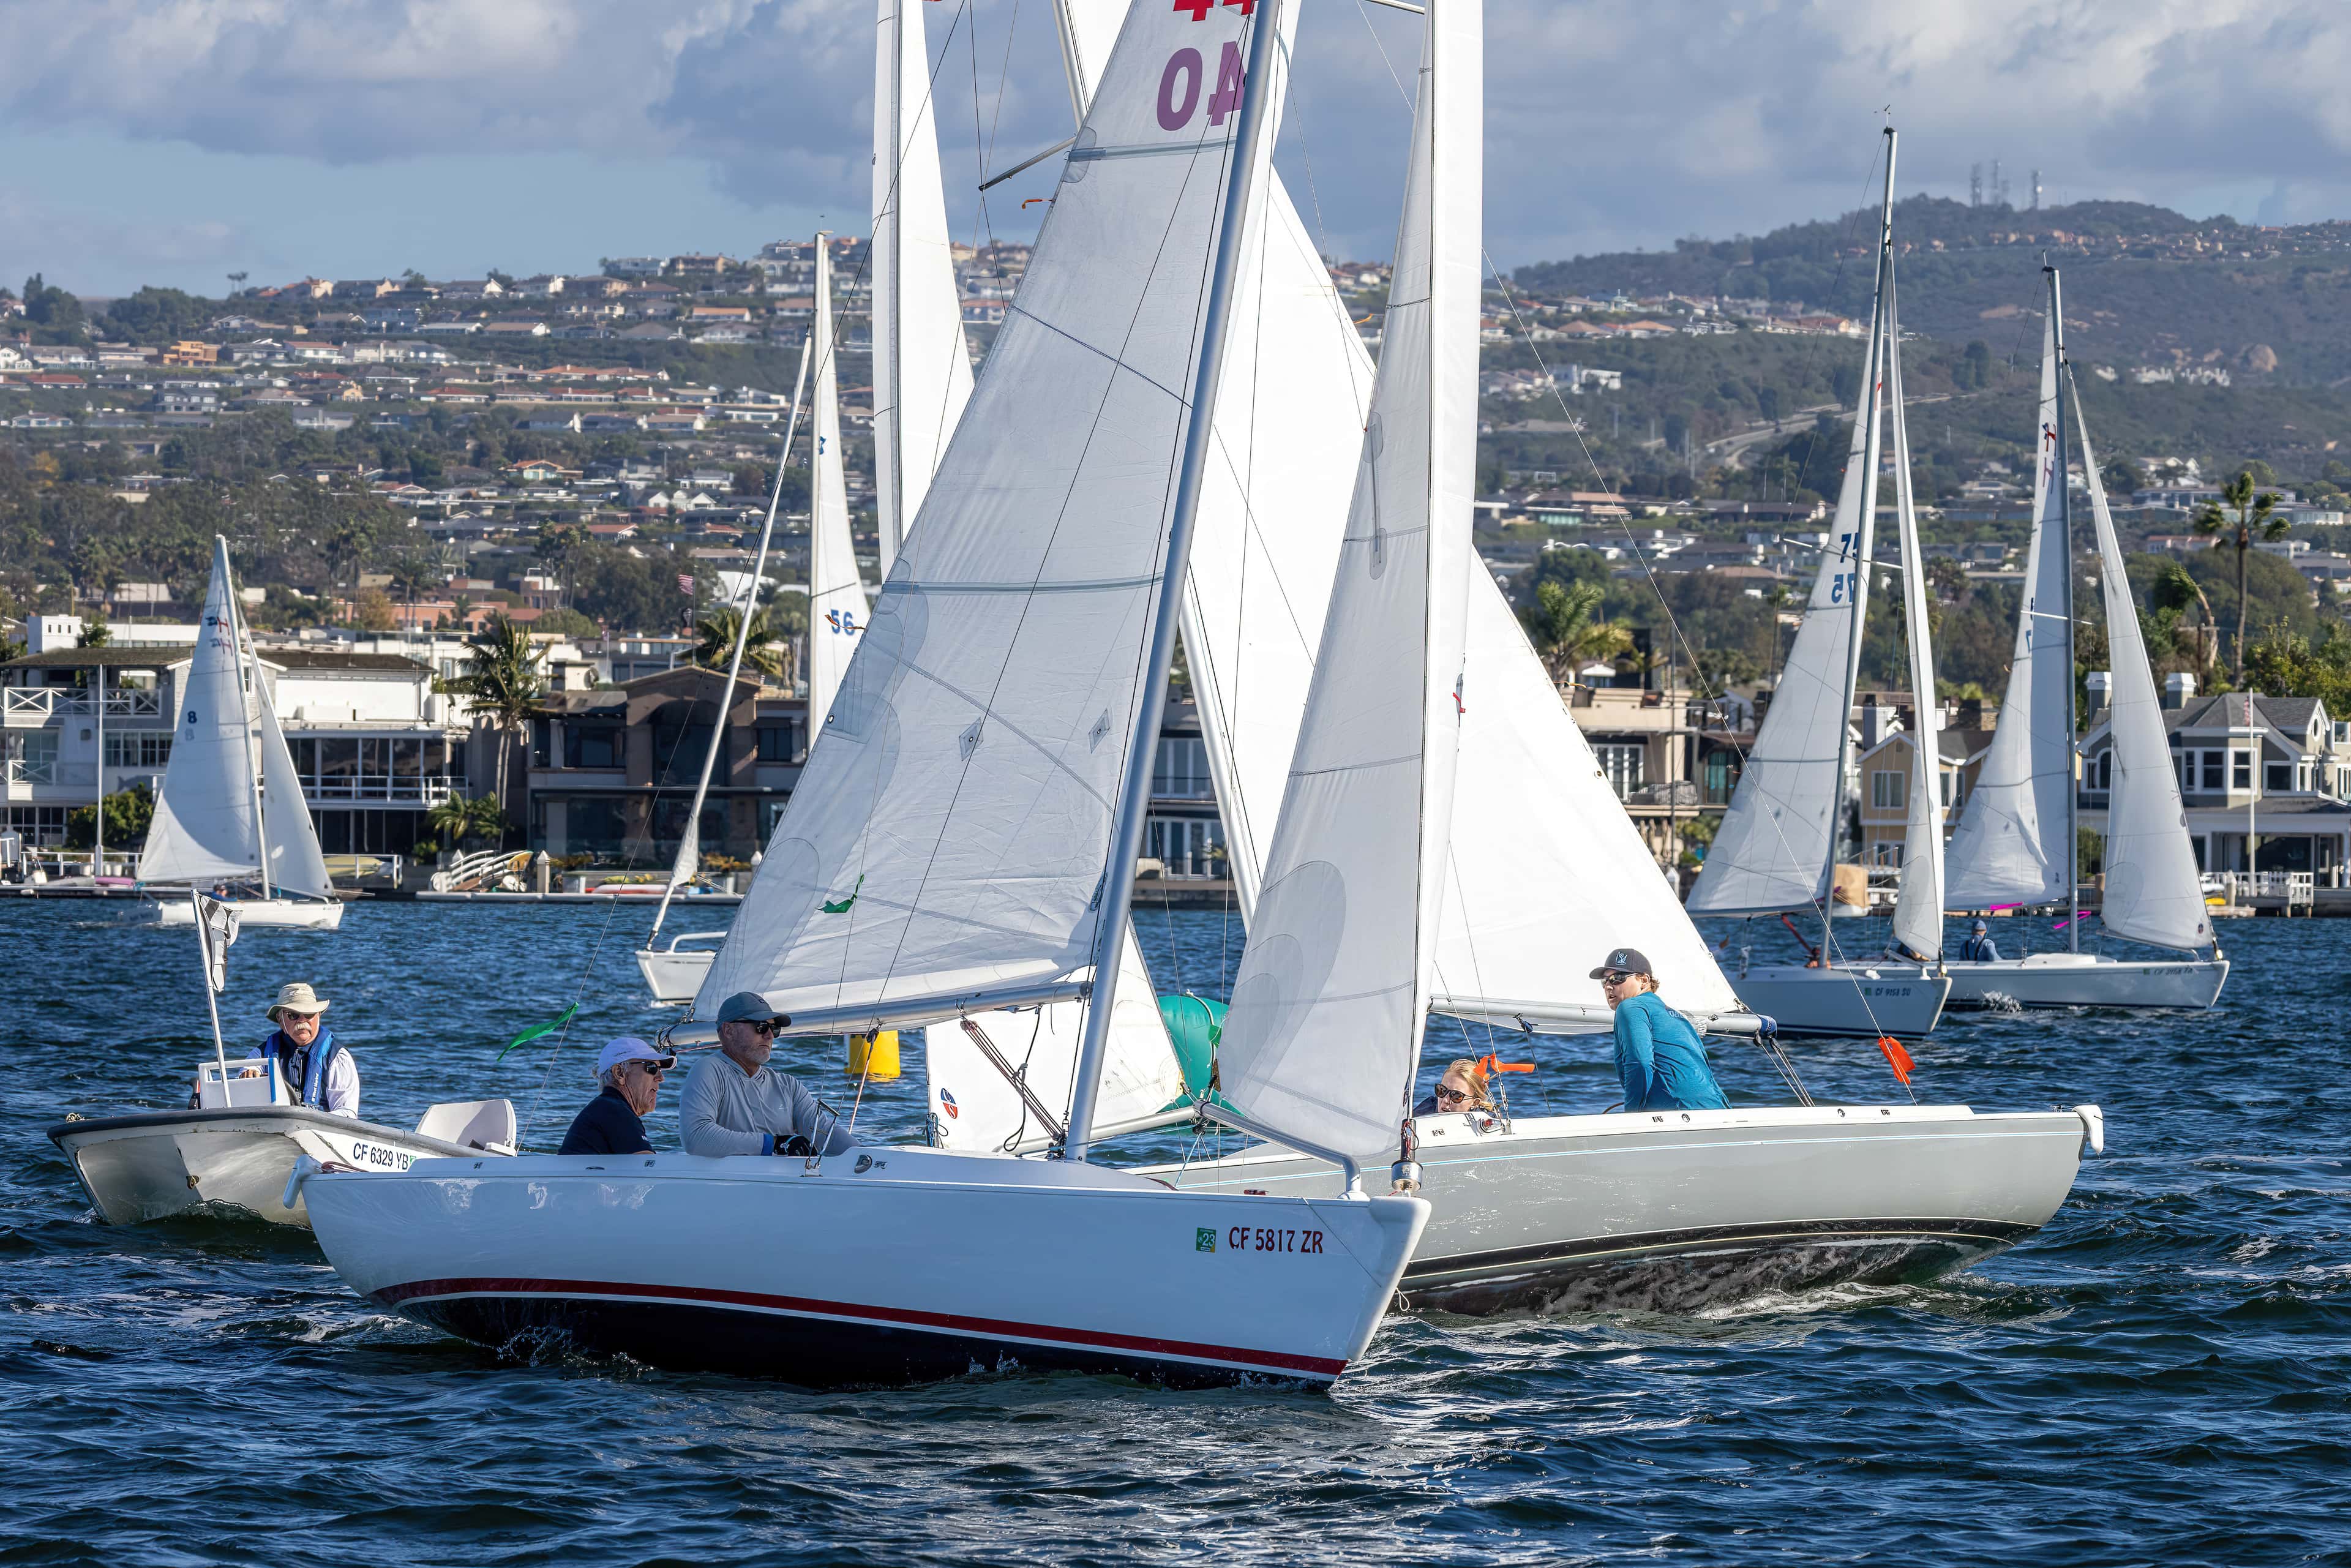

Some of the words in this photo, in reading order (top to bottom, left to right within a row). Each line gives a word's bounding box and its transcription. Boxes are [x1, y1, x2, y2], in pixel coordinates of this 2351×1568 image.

[831, 609, 855, 636] 56
[187, 710, 197, 724] 8
[1875, 988, 1884, 996] CF
[353, 1142, 369, 1161] CF
[370, 1147, 393, 1167] 6329
[396, 1152, 408, 1170] YB
[1202, 1232, 1215, 1247] 23
[1229, 1226, 1251, 1250] CF
[1255, 1228, 1295, 1253] 5817
[1300, 1231, 1323, 1254] ZR
